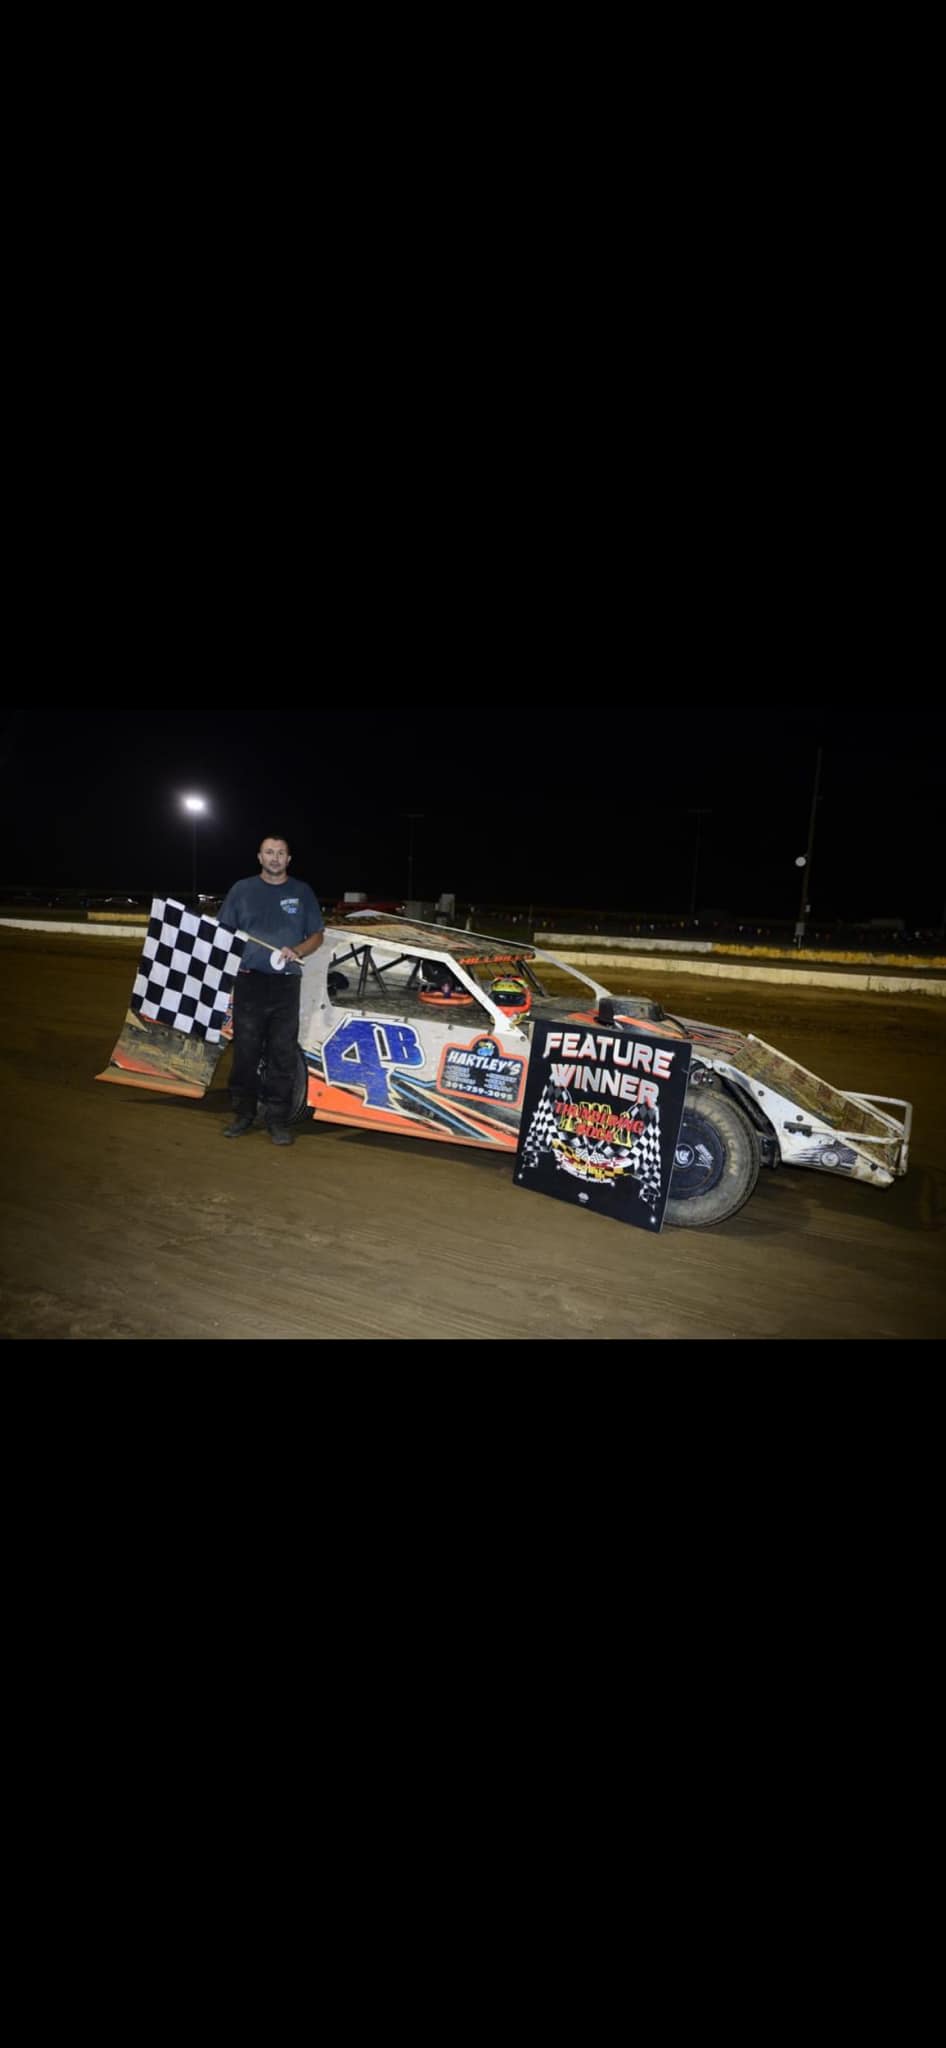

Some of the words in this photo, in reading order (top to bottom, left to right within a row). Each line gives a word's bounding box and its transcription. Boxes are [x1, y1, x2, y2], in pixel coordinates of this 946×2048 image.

[447, 1050, 522, 1076] HARTLEY'S
[542, 1032, 675, 1080] FEATURE
[550, 1063, 659, 1109] WINNER
